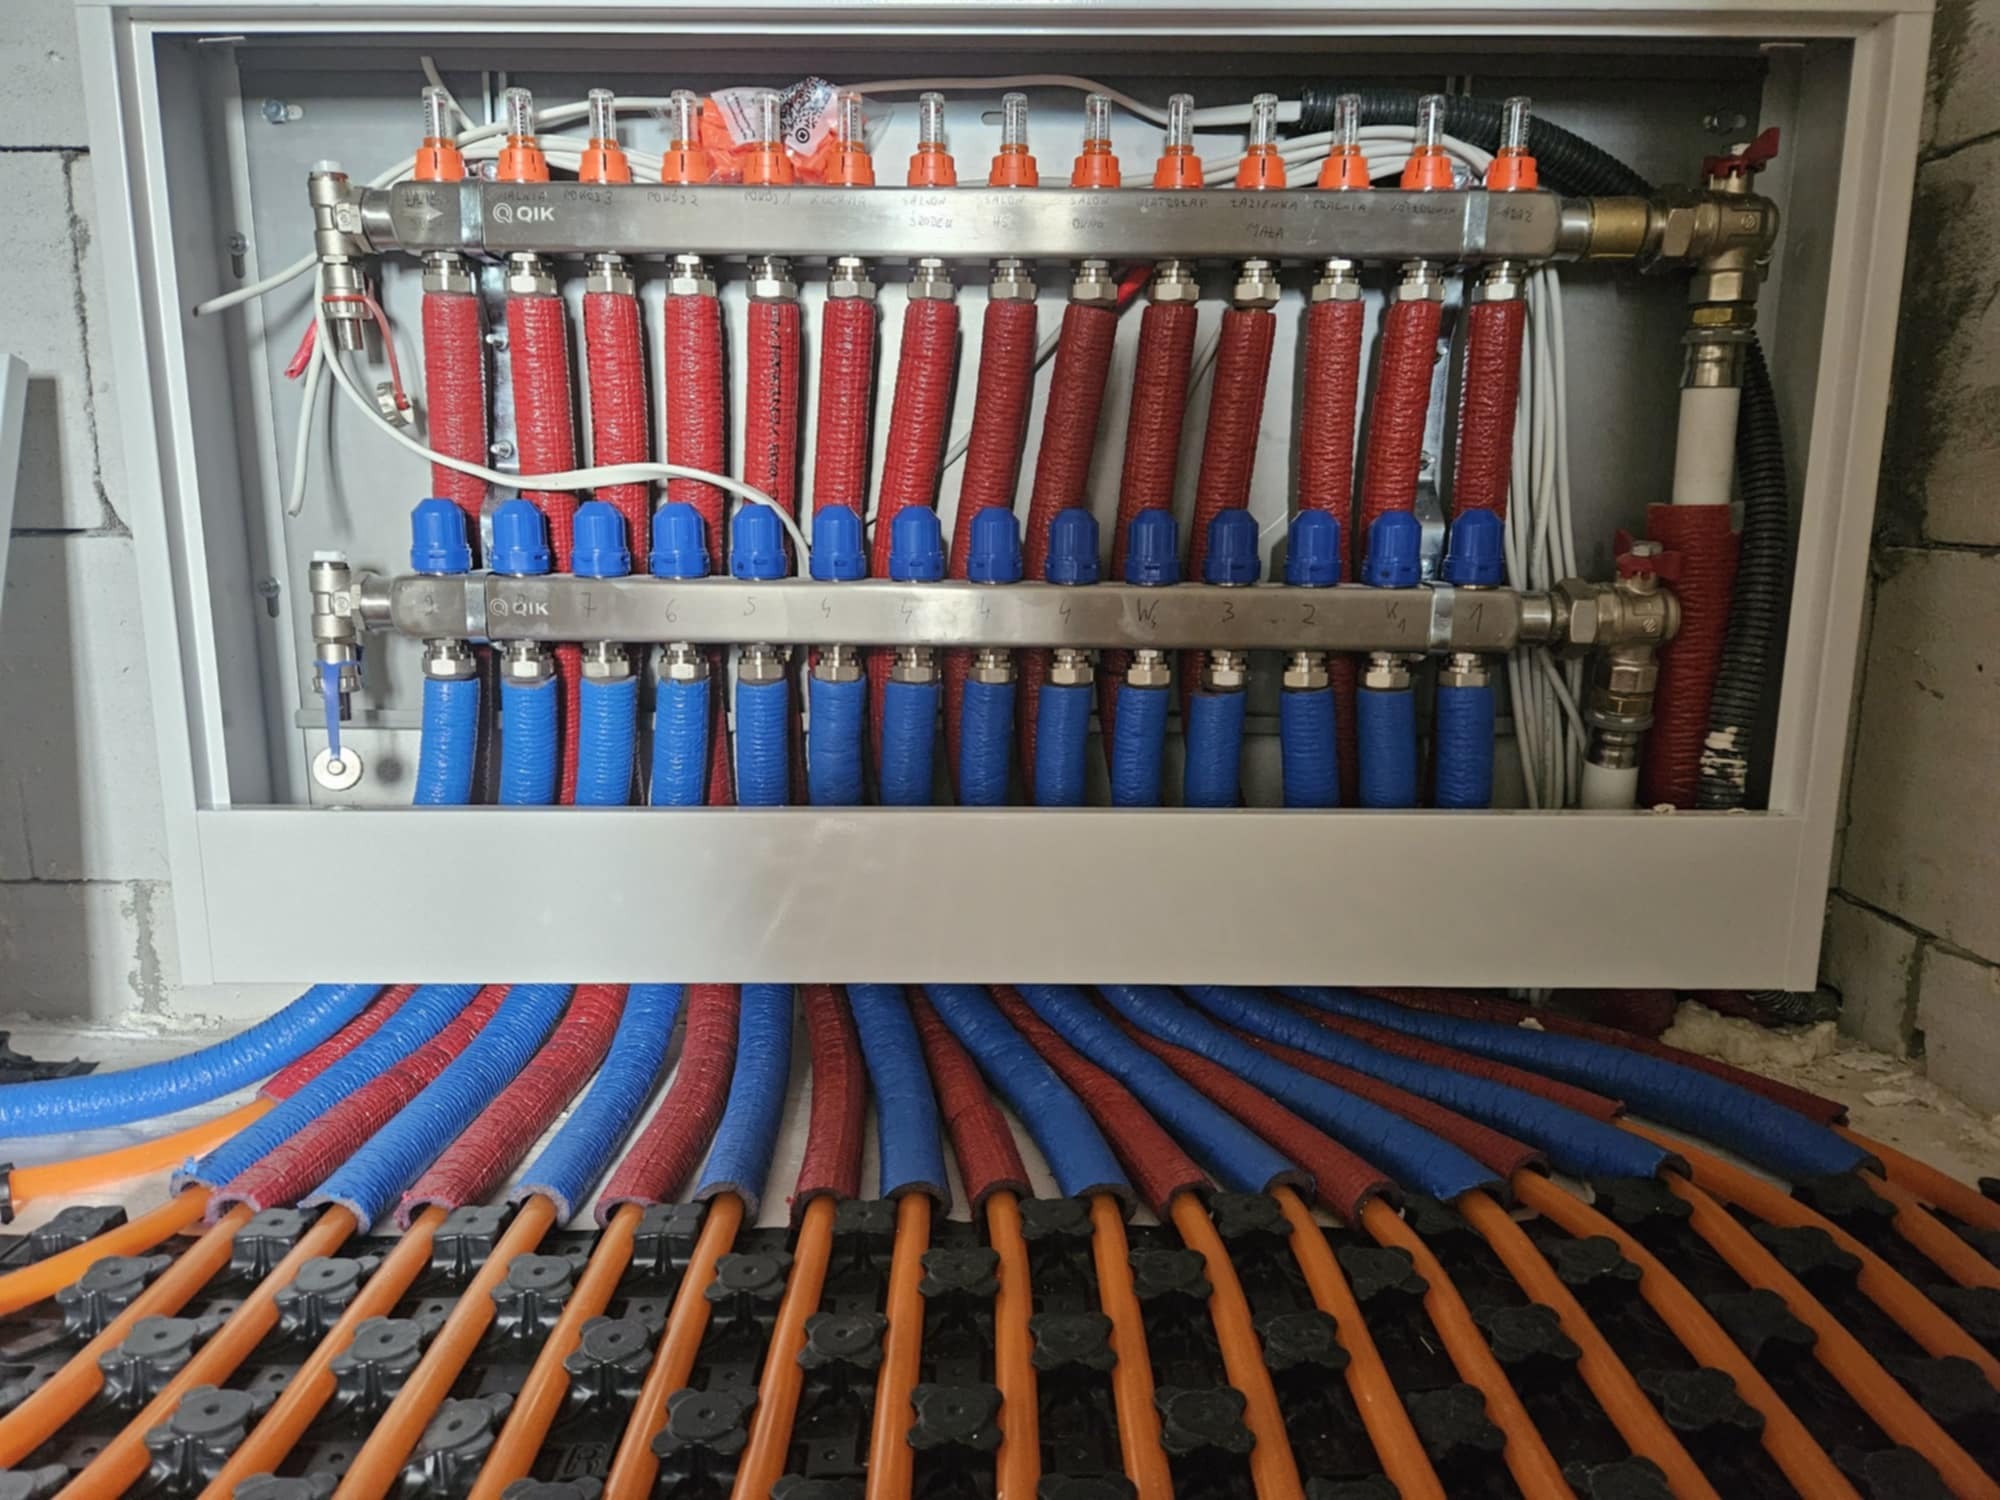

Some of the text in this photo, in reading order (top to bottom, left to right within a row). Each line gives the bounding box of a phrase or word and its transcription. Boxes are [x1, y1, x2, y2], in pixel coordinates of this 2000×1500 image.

[690, 194, 699, 207] 2
[517, 207, 555, 224] QIK
[512, 601, 550, 616] QIK
[581, 592, 597, 617] 7
[664, 598, 678, 624] 6
[743, 596, 757, 616] 5
[1060, 599, 1073, 624] 4
[1219, 600, 1235, 624] 3
[1301, 603, 1316, 625] 2
[1469, 603, 1484, 632] 1
